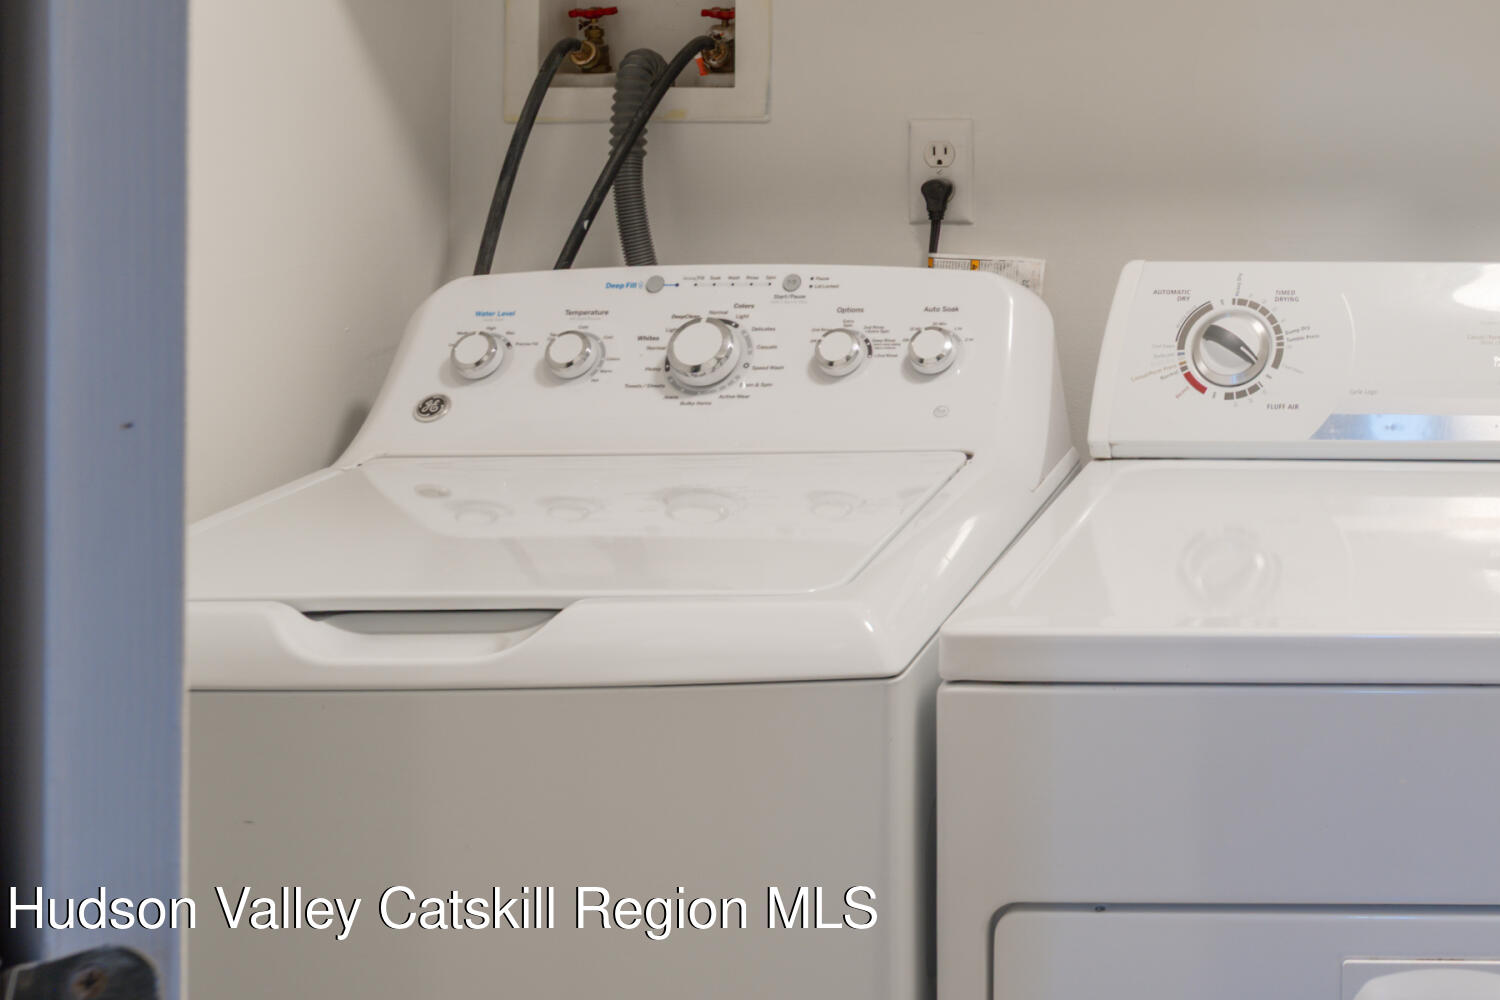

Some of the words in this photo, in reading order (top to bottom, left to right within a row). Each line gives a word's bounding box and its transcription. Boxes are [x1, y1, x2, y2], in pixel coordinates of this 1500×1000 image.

[605, 282, 625, 290] Deep
[625, 281, 637, 289] Fill
[565, 309, 610, 317] Temperature
[836, 306, 865, 314] Options
